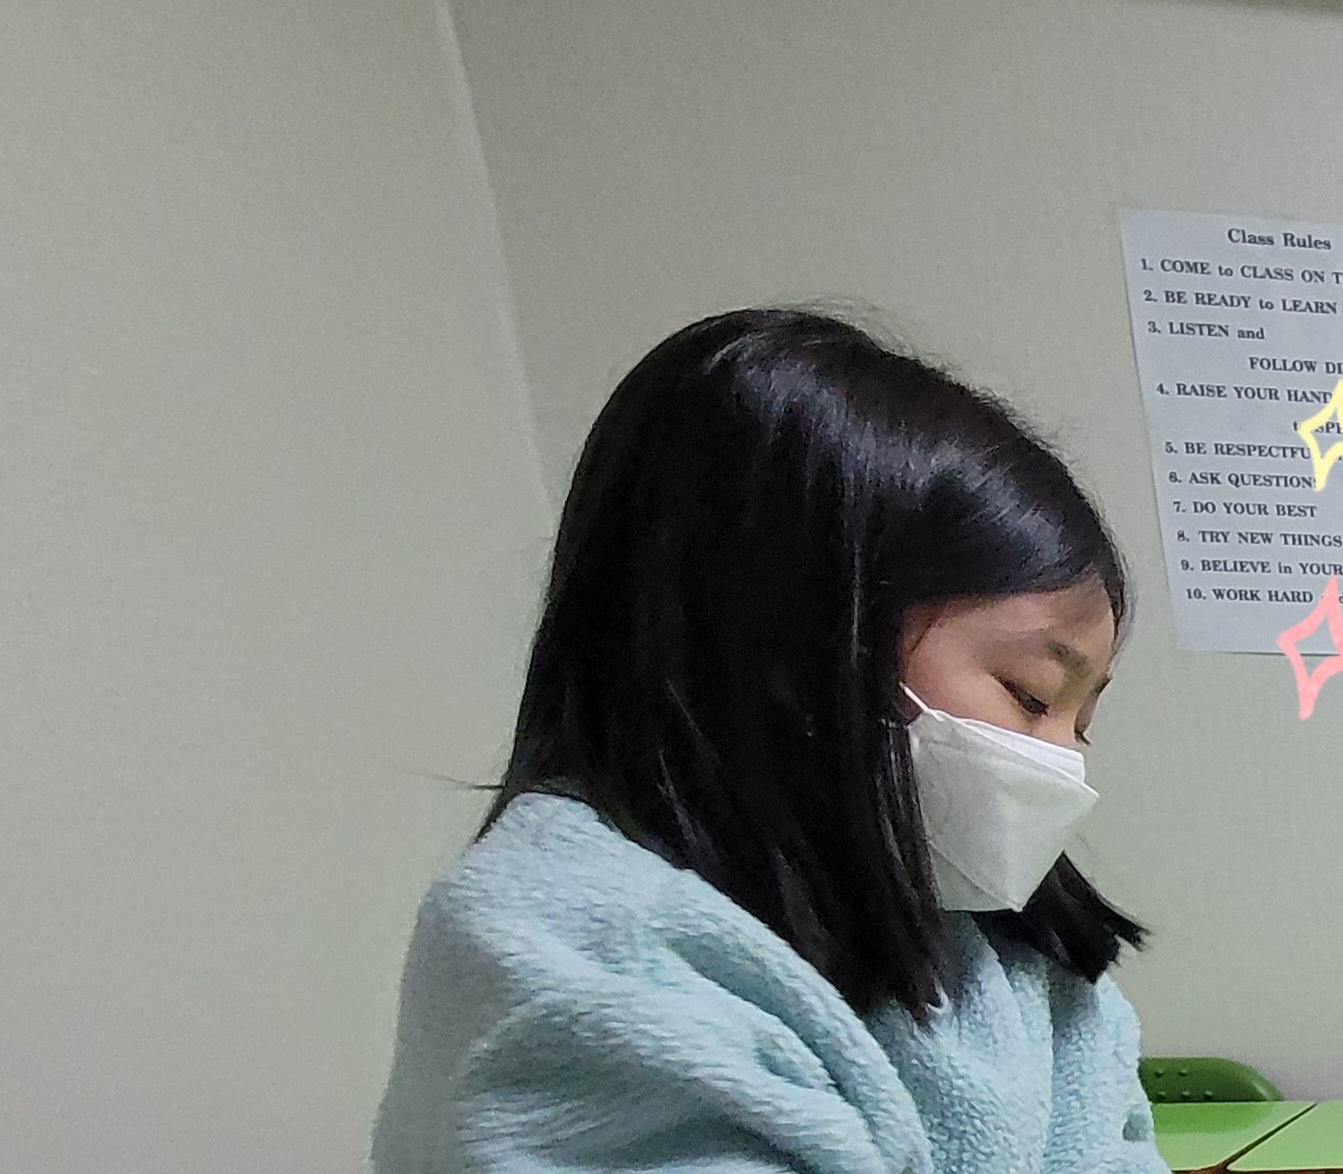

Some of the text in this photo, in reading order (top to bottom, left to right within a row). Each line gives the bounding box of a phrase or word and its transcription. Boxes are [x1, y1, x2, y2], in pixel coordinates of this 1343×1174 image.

[1226, 227, 1333, 250] Class Rules
[1140, 258, 1154, 271] 1.
[1159, 258, 1212, 276] COME
[1217, 264, 1235, 278] to
[1240, 265, 1295, 282] CLASS
[1301, 269, 1326, 284] ON
[1143, 289, 1338, 315] 2. BE READY to LEARN
[1147, 320, 1266, 341] 3. LISTEN and
[1248, 356, 1319, 374] FOLLOW
[1156, 383, 1333, 405] 4. RAISE YOUR HAND
[1164, 441, 1179, 455] 5.
[1184, 441, 1208, 456] BE
[1168, 471, 1183, 485] 6.
[1188, 472, 1223, 486] ASK
[1172, 501, 1318, 519] 7. DO YOUR BEST
[1176, 530, 1343, 549] 8. TRY NEW THINGS
[1180, 559, 1195, 572] 9.
[1200, 560, 1272, 574] BELIEVE
[1278, 562, 1293, 575] in
[1186, 587, 1207, 601] 10.
[1211, 588, 1262, 603] WORK
[1267, 590, 1314, 604] HARD
